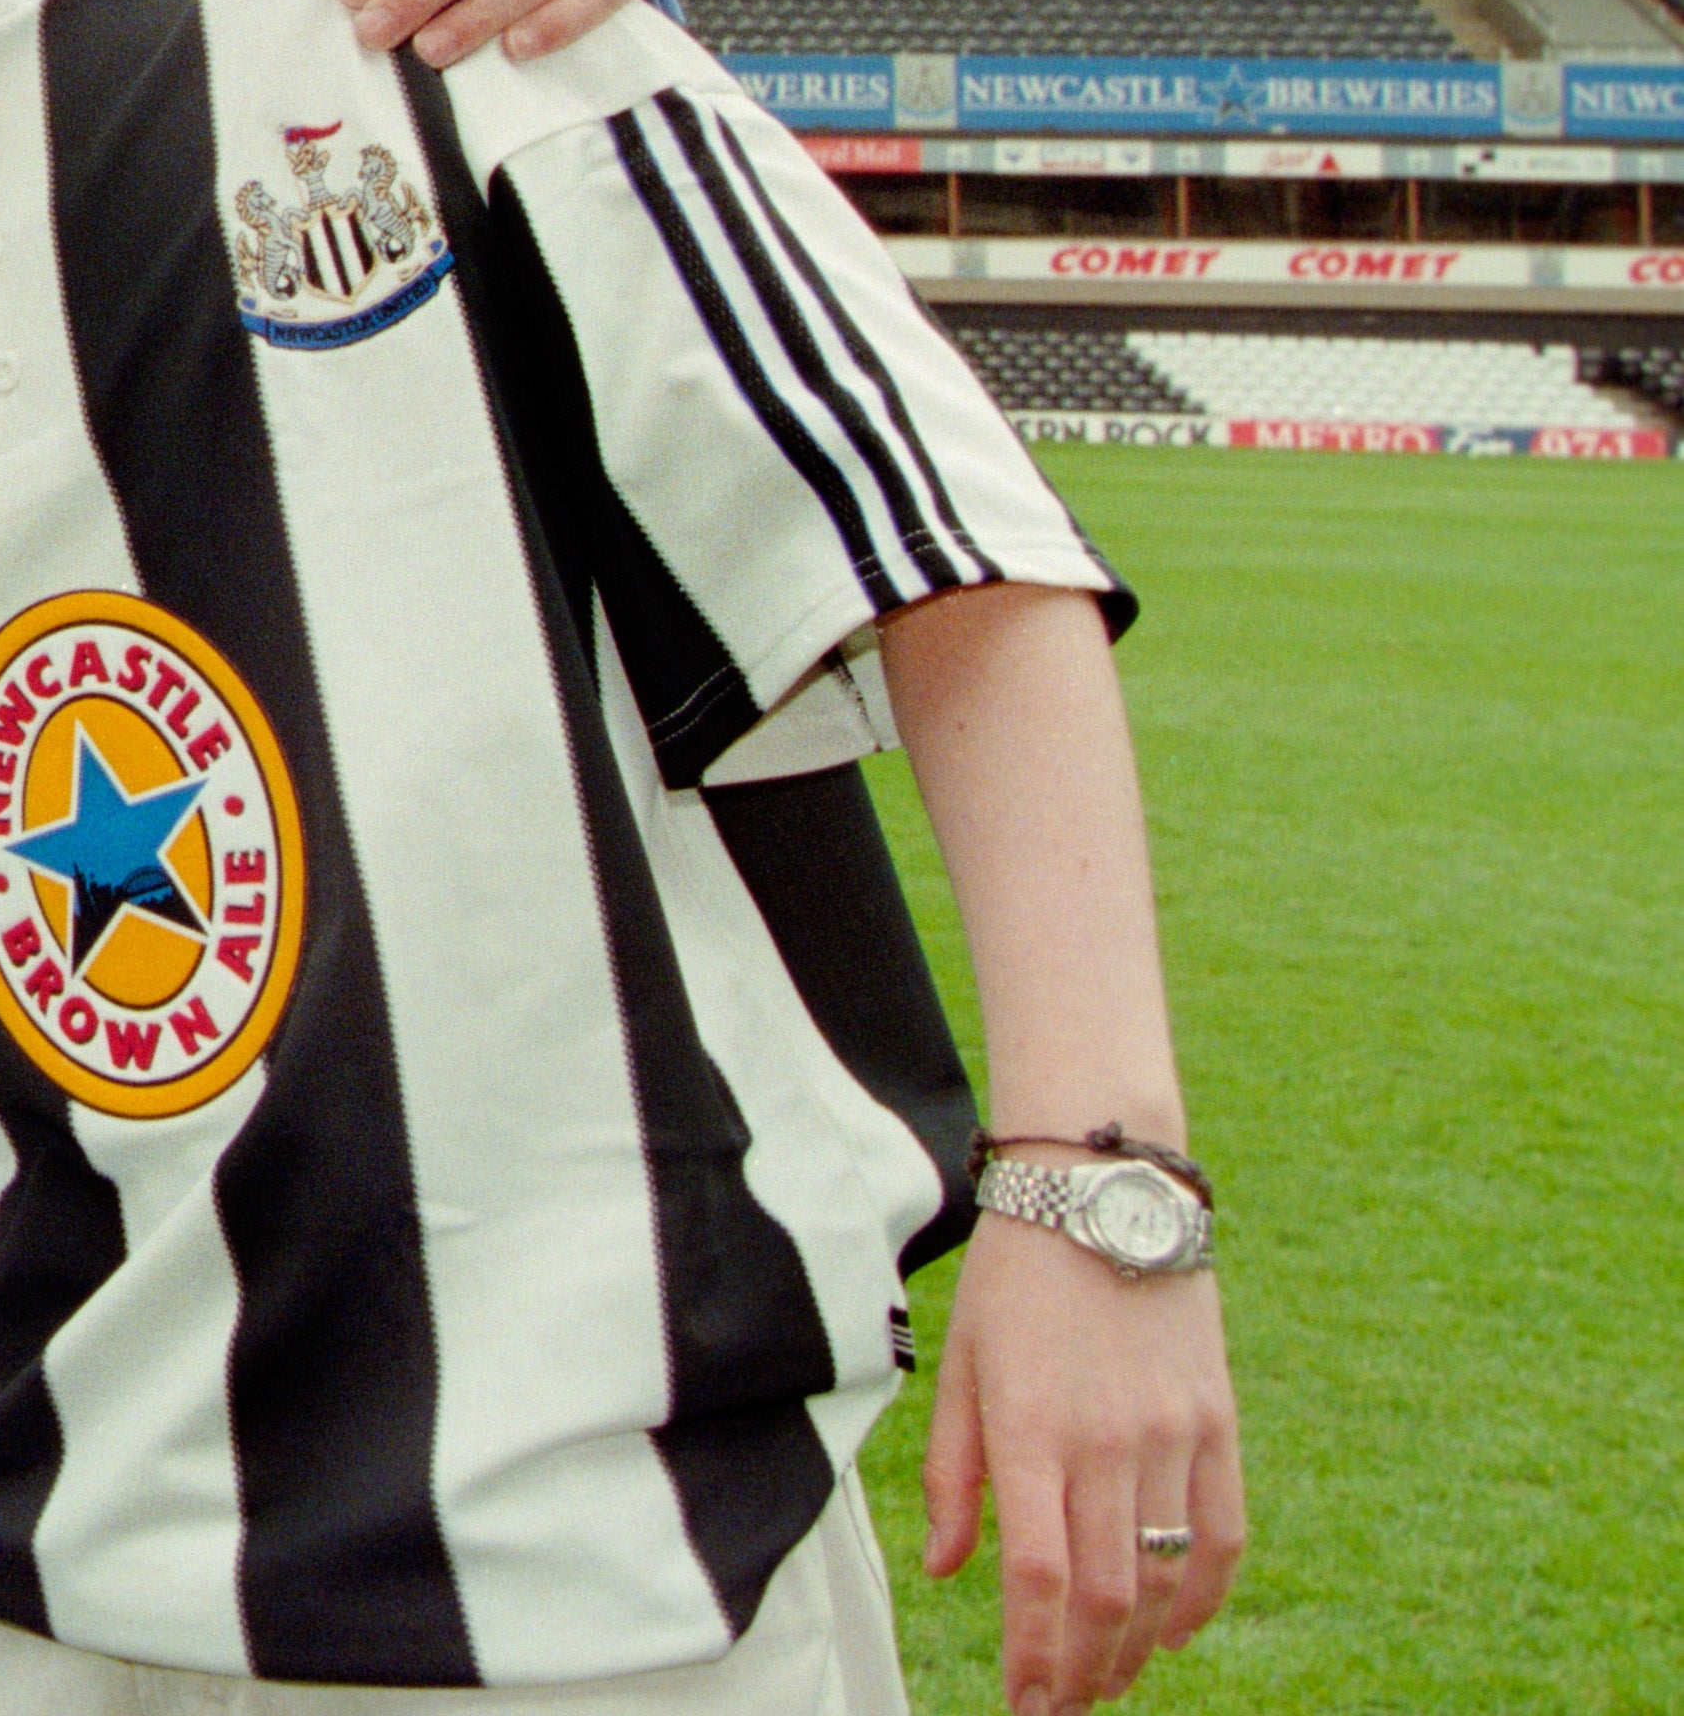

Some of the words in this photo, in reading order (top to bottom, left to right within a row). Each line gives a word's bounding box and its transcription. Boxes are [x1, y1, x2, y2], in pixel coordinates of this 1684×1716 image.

[744, 73, 890, 102] WERIES
[963, 74, 1198, 105] NEWCASTLE
[1266, 77, 1497, 108] BREWERIES
[1572, 81, 1684, 111] NEWC
[1050, 246, 1220, 277] COMET
[1287, 249, 1460, 280] COMET
[1627, 255, 1684, 284] CO
[1103, 421, 1213, 447] ROCK
[1255, 422, 1432, 454] METRO
[1, 916, 222, 1072] BROWN
[214, 848, 266, 984] ALE
